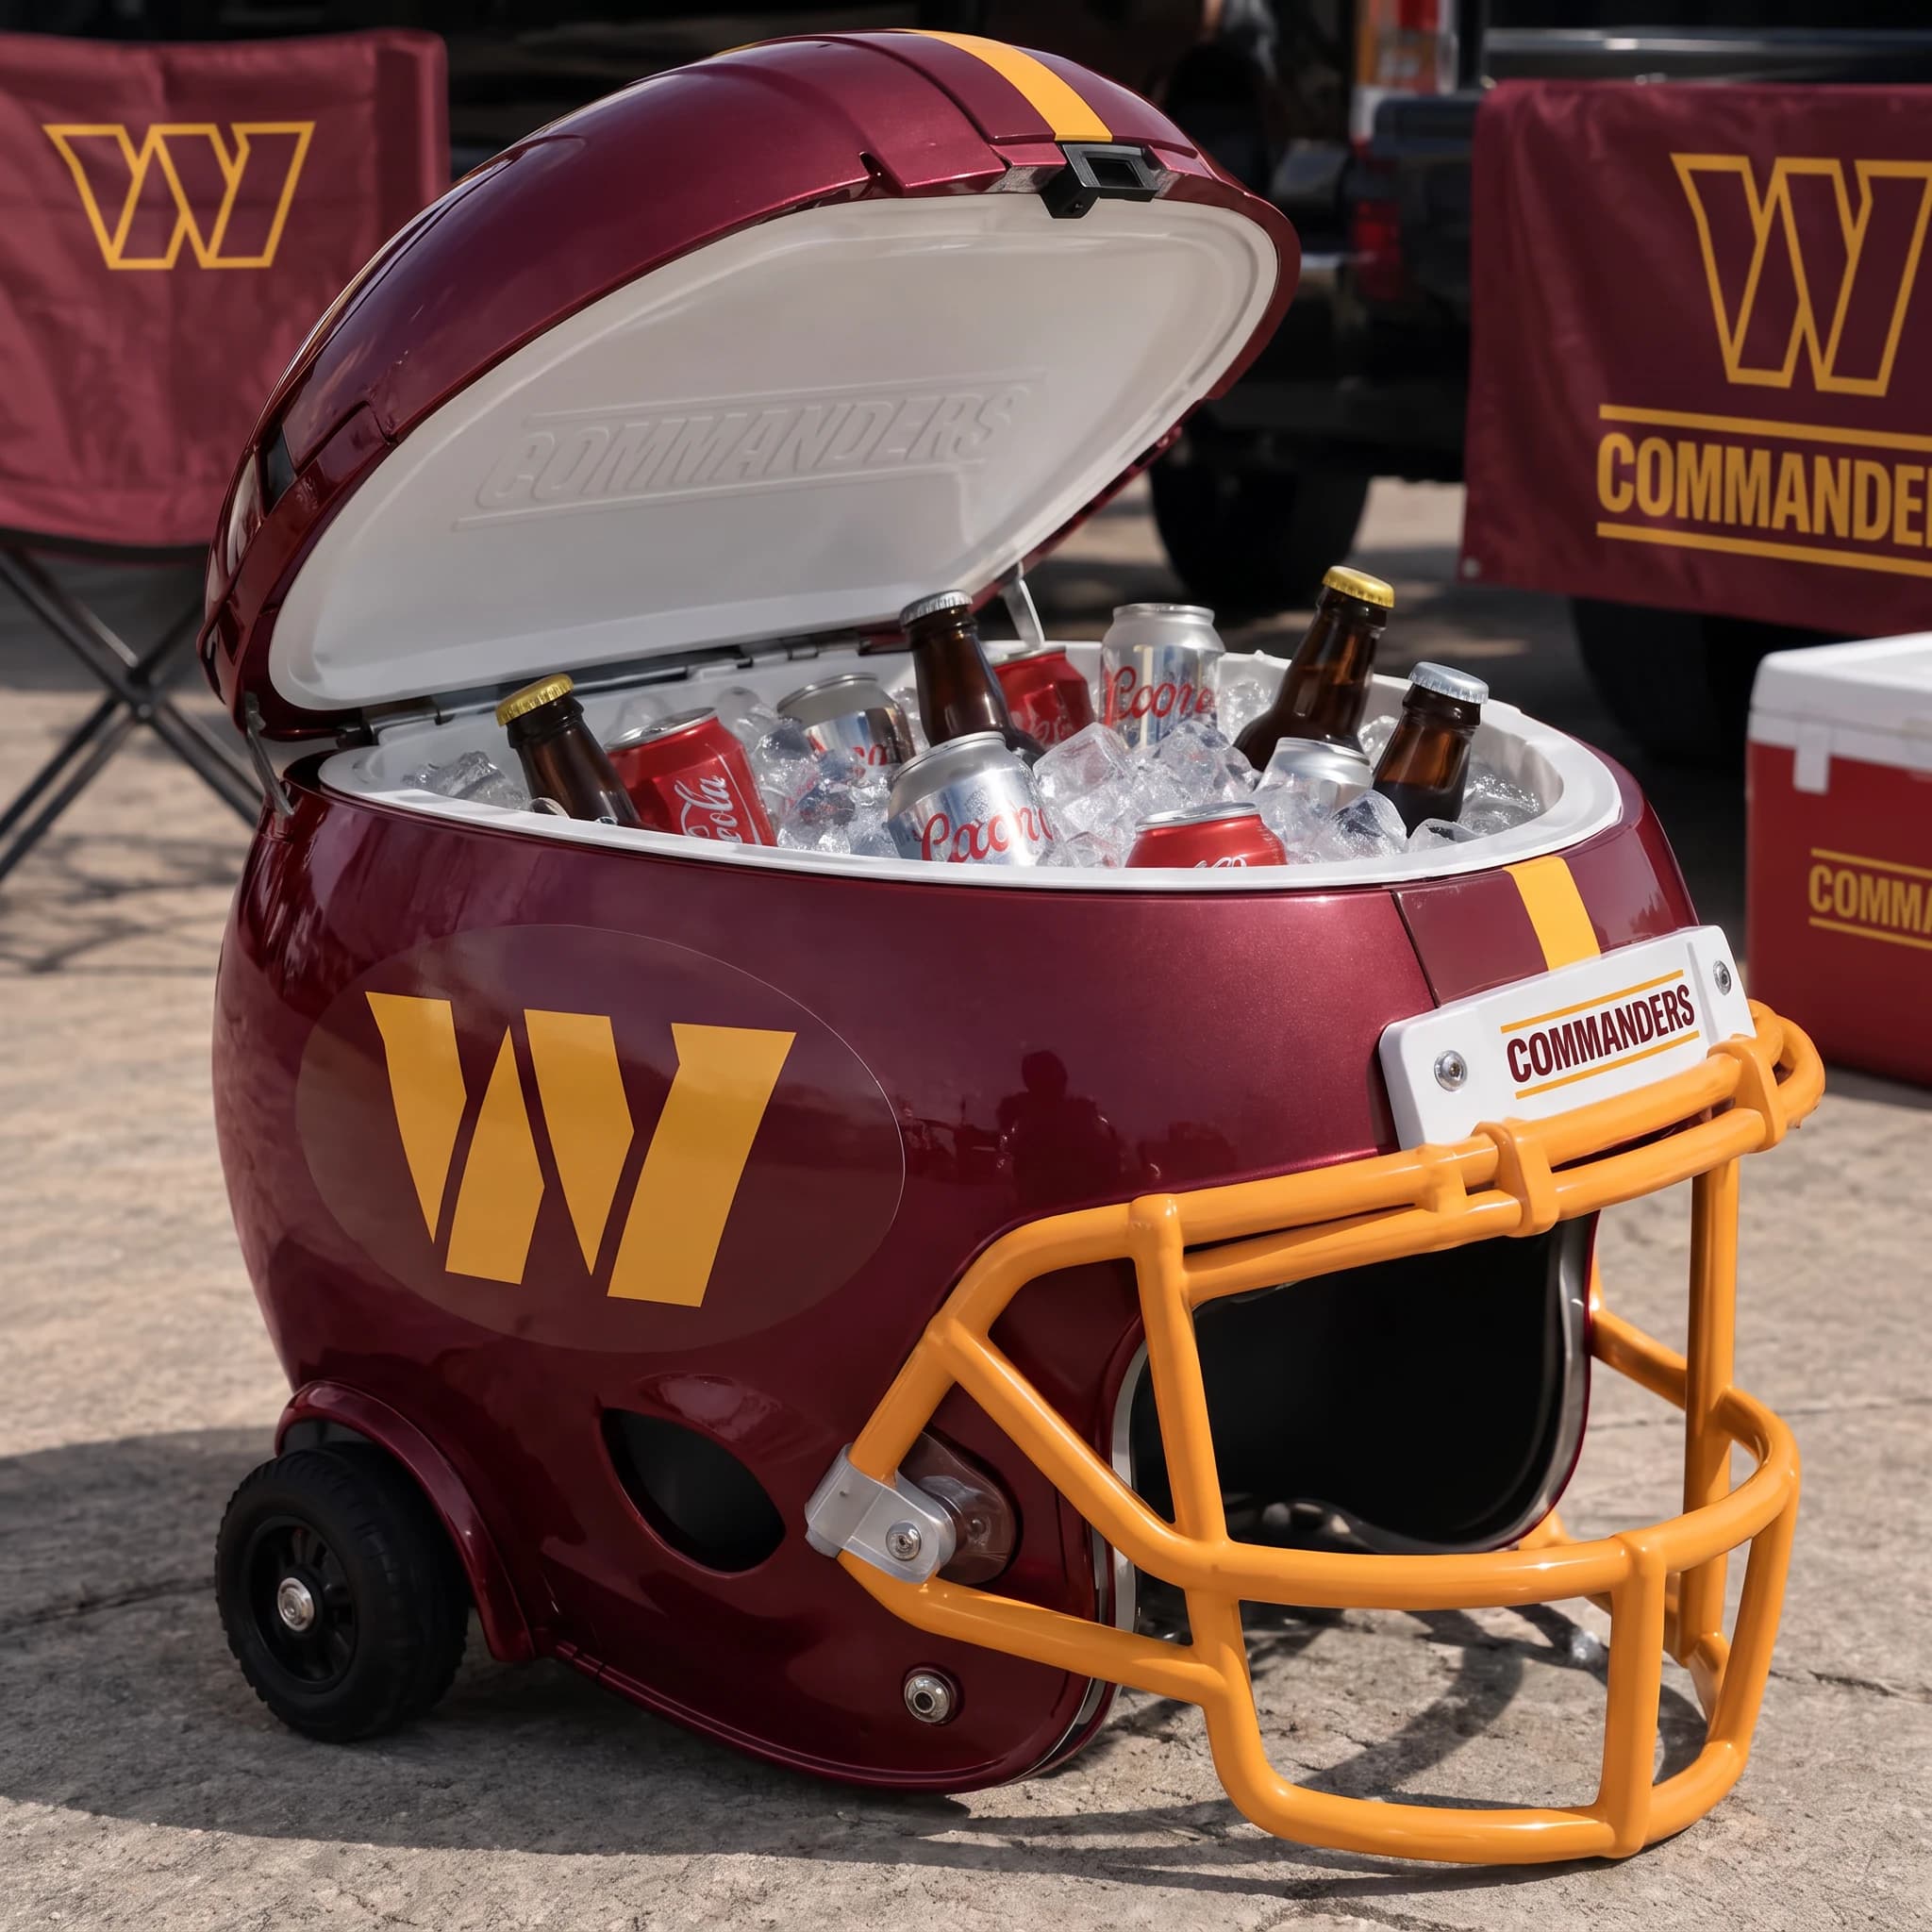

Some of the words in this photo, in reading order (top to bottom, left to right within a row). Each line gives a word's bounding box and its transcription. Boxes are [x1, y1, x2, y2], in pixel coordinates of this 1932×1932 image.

[42, 121, 315, 270] W
[1671, 153, 1932, 397] W
[475, 384, 1030, 509] COMMANDERS
[1597, 432, 1932, 548] COMMANDE
[1507, 984, 1695, 1083] COMMANDERS
[365, 991, 796, 1307] W
